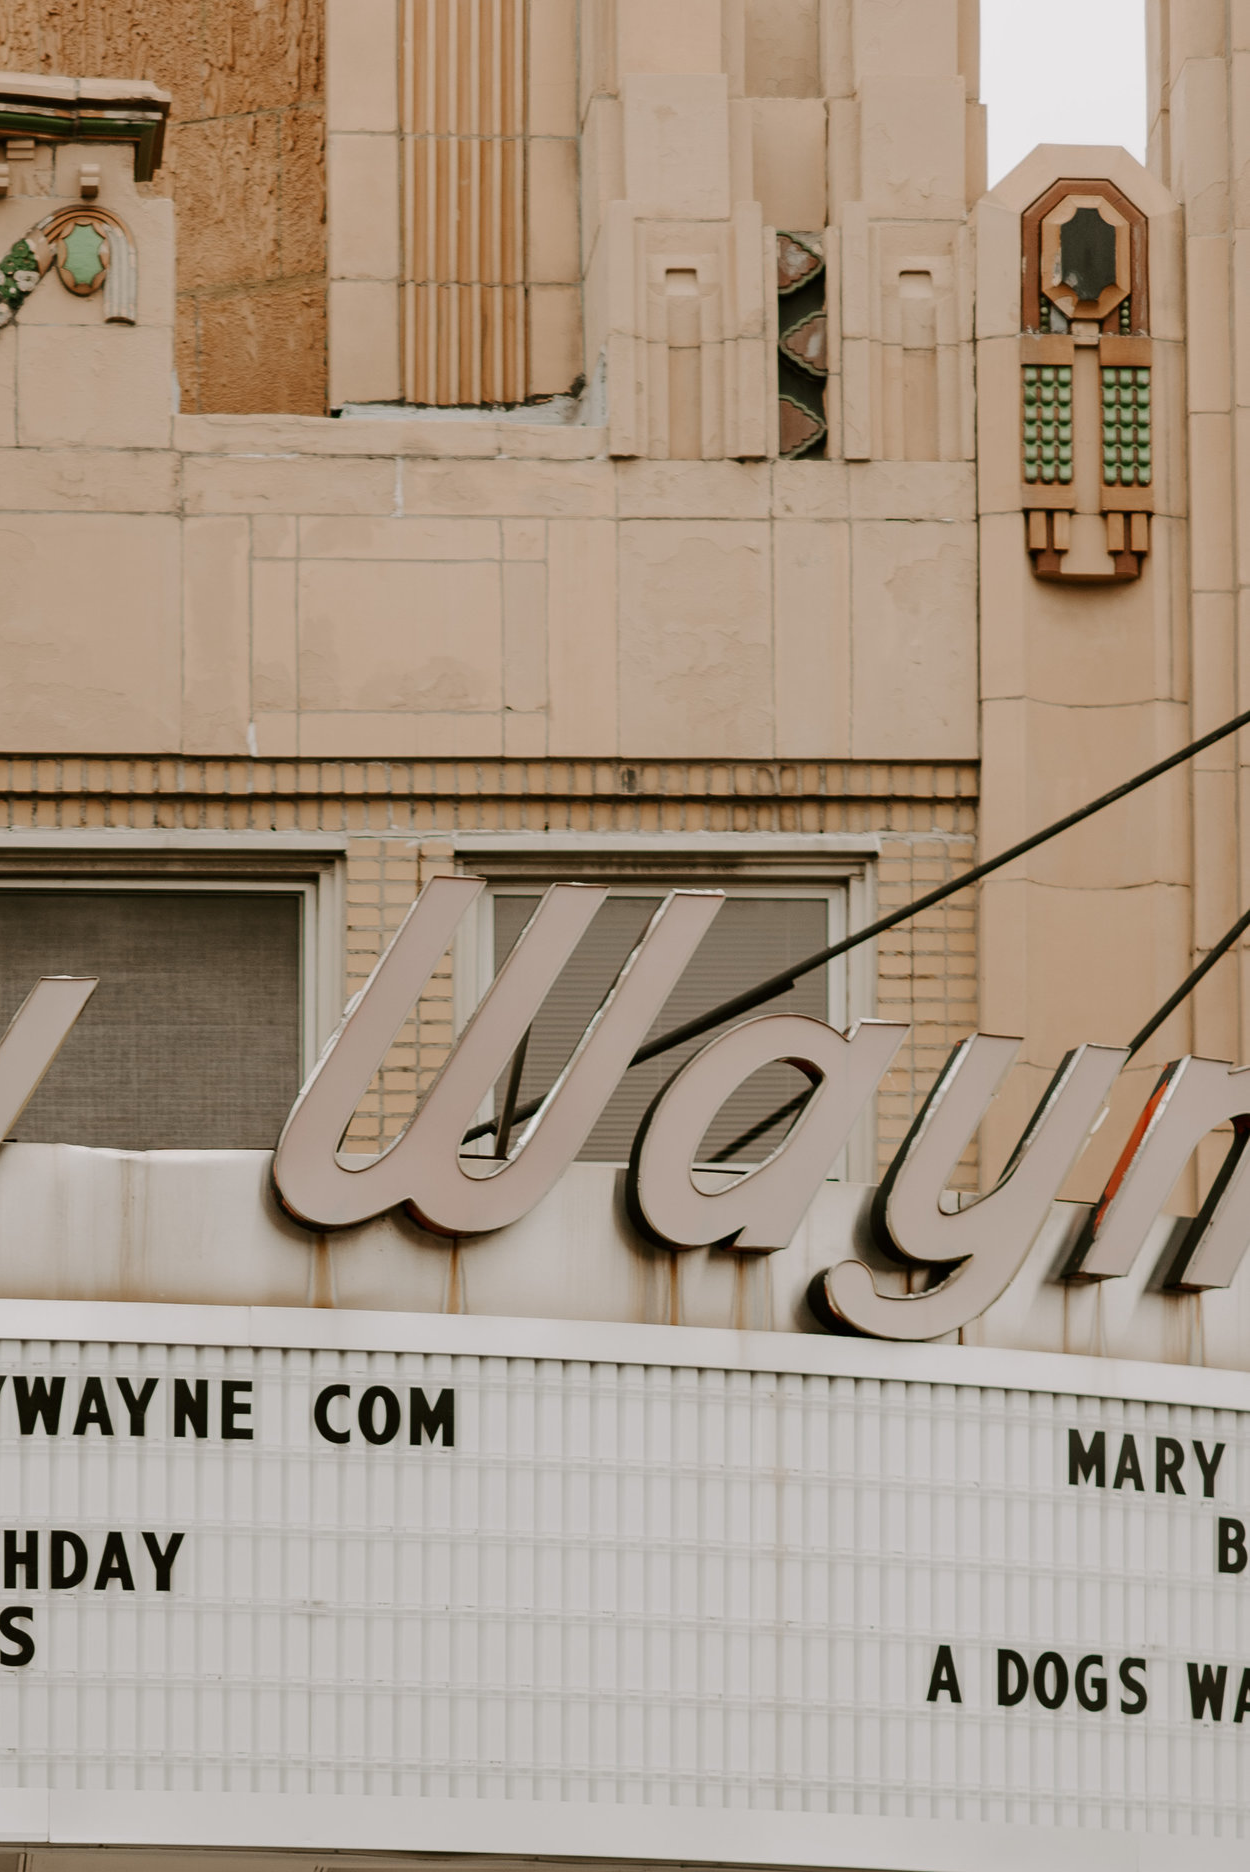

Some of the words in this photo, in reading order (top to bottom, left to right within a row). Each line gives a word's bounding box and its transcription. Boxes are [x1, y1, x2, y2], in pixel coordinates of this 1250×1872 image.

[313, 1383, 458, 1448] COM
[1068, 1428, 1226, 1498] MARY
[926, 1644, 963, 1703] A
[997, 1648, 1149, 1715] DOGS
